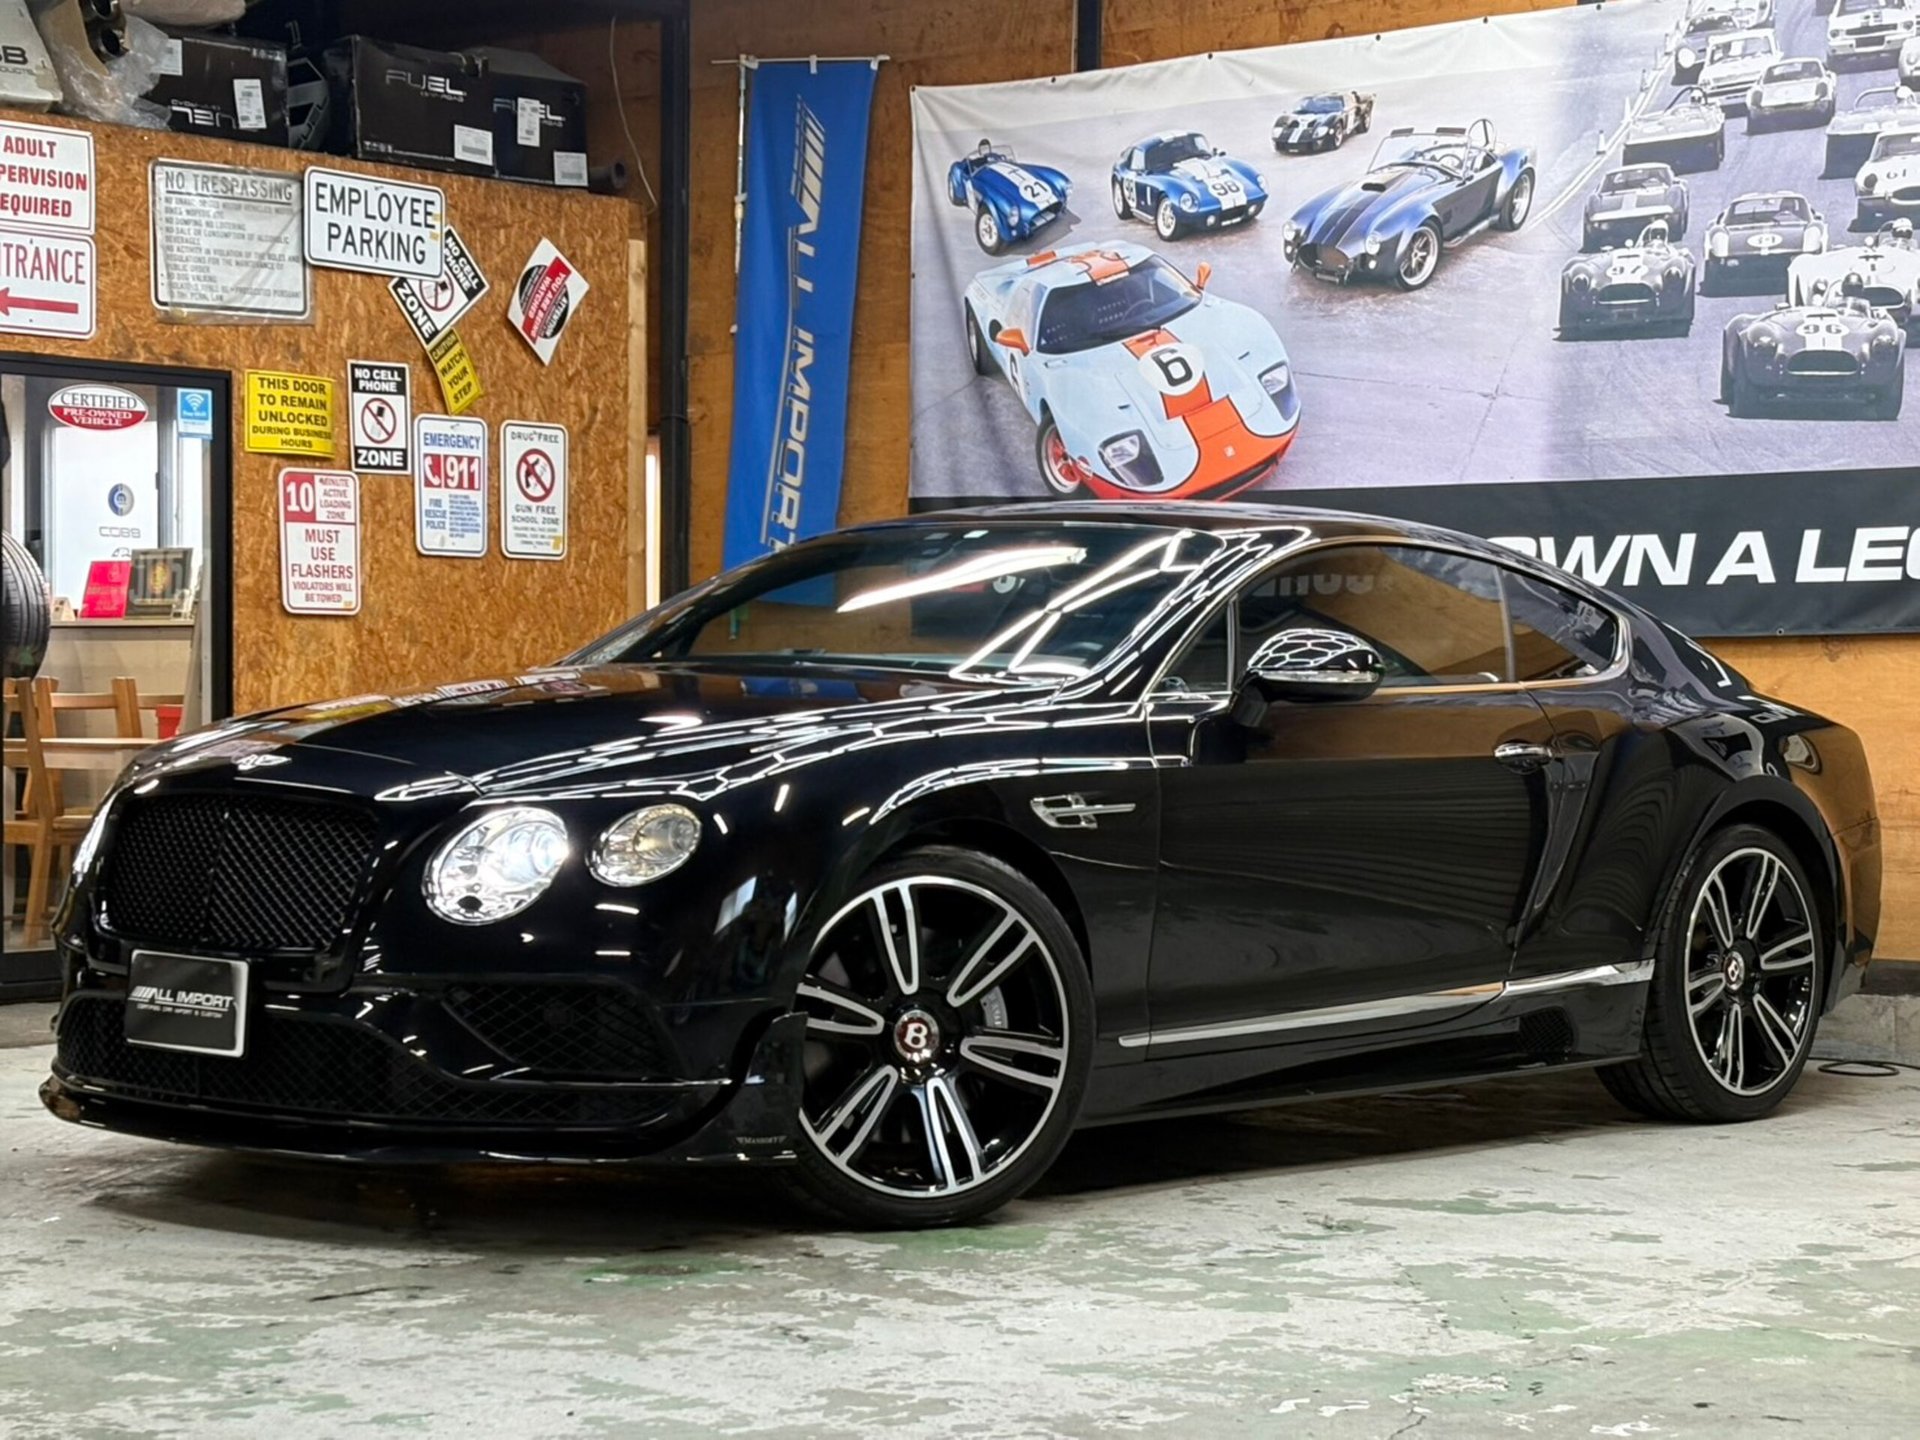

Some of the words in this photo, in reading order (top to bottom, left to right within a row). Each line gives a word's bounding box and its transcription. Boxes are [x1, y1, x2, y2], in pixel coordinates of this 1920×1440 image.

[0, 45, 28, 65] B
[386, 69, 467, 96] FUEL
[171, 104, 238, 129] UEL
[493, 98, 566, 122] FEL
[4, 135, 57, 159] ADULT
[165, 172, 186, 190] NO
[192, 174, 292, 200] TRESPASSING
[1024, 182, 1048, 199] 21
[1212, 180, 1240, 196] 98
[316, 182, 436, 229] EMPLOYEE
[328, 222, 426, 265] PARKING
[444, 249, 472, 292] PHONE
[446, 236, 460, 256] NO
[458, 256, 480, 290] CELL
[1612, 264, 1640, 276] 97
[553, 272, 566, 290] YOU
[528, 276, 552, 320] WATCHED
[542, 288, 556, 310] ARE
[397, 281, 436, 339] ZONE
[1803, 324, 1842, 335] 96
[440, 350, 466, 377] WATCH
[1151, 349, 1193, 388] 6
[354, 368, 371, 380] NO
[372, 370, 402, 381] CELL
[447, 366, 469, 390] YOUR
[258, 377, 290, 390] THIS
[293, 380, 326, 395] DOOR
[359, 380, 398, 392] PHONE
[453, 381, 474, 404] STEP
[60, 392, 137, 409] CERTIFIED
[258, 394, 276, 406] TO
[280, 395, 328, 411] REMAIN
[63, 408, 132, 420] PRE-OWNED
[72, 416, 122, 426] VEHICLE
[258, 410, 328, 427] UNLOCKED
[252, 426, 290, 436] DURING
[281, 438, 313, 449] HOURS
[424, 432, 481, 450] EMERGENCY
[358, 450, 404, 466] ZONE
[446, 456, 480, 490] 911
[286, 482, 314, 512] 10
[515, 504, 532, 514] GUN
[536, 505, 556, 516] FREE
[512, 516, 538, 525] SCHOOL
[305, 529, 340, 544] MUST
[311, 547, 336, 561] USE
[1707, 531, 1777, 585] A
[291, 564, 354, 580] FLASHERS
[176, 990, 234, 1009] IMPORT
[904, 1022, 928, 1048] B
